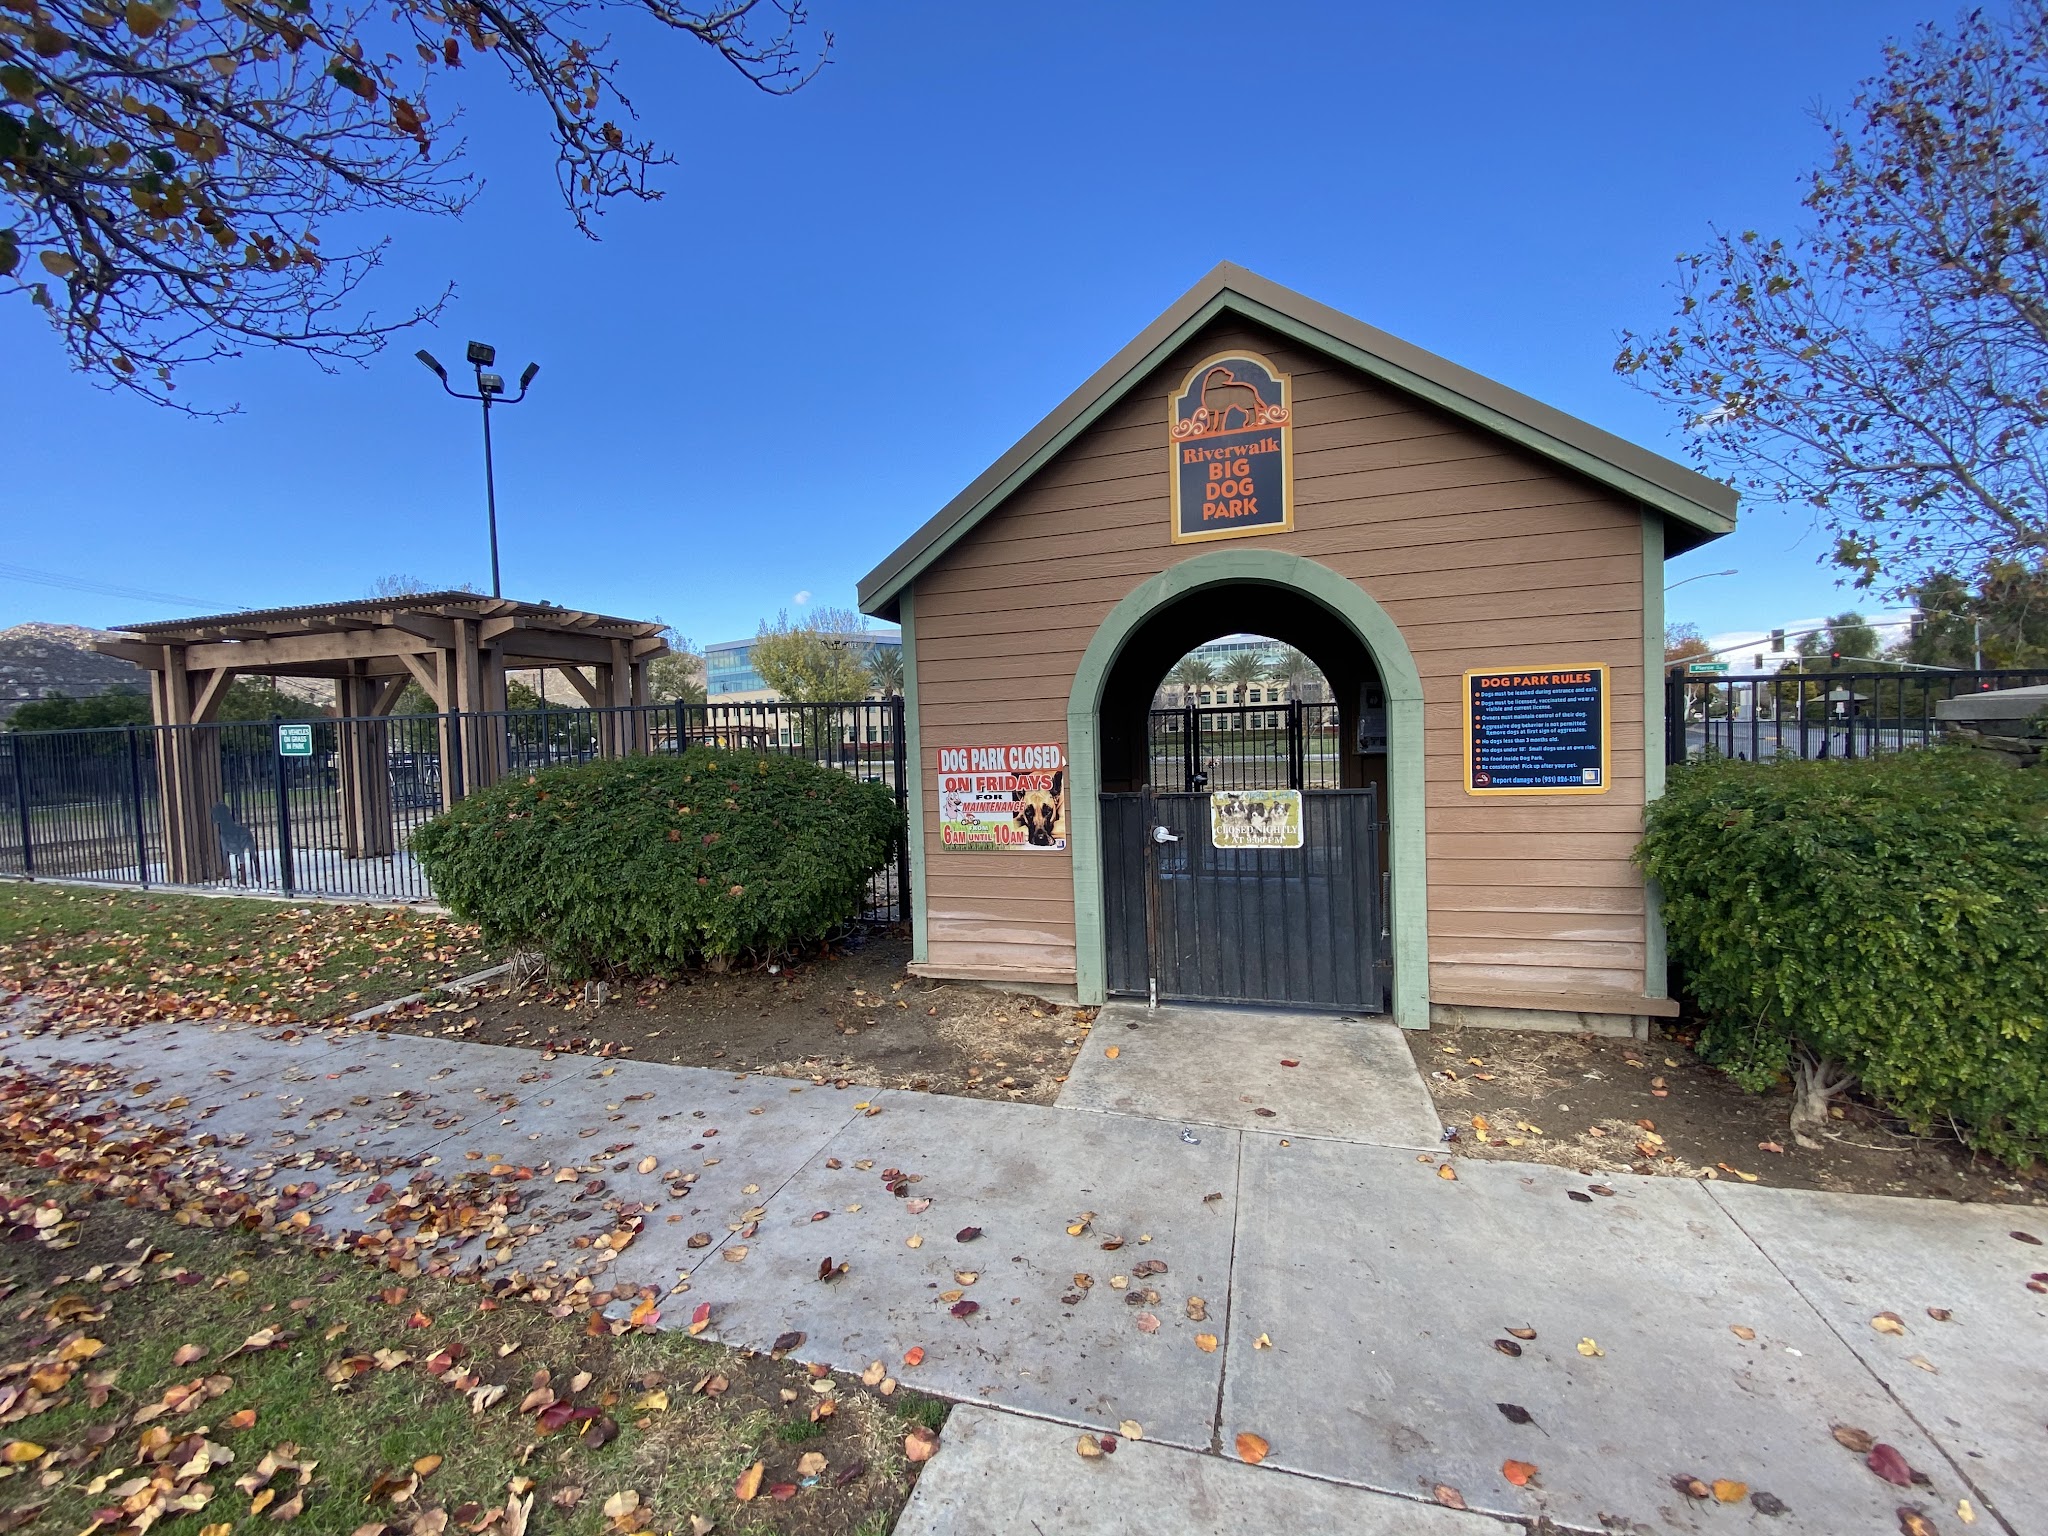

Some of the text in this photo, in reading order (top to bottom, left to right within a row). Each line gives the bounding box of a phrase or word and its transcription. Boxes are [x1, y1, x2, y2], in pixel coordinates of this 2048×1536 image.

[1183, 437, 1280, 465] Riverwalk
[1209, 459, 1250, 481] BIG
[1205, 478, 1254, 501] DOG
[1202, 497, 1258, 521] PARK
[1481, 674, 1591, 688] DOG PARK RULES
[941, 746, 1060, 772] DOG PARK CLOSED
[945, 774, 1053, 792] ON FRIDAYS
[1542, 776, 1556, 784] (951)
[962, 802, 1025, 812] MAINTENANCE
[968, 834, 992, 842] UNTIL
[1216, 826, 1298, 834] CLOSED NIGHTLY
